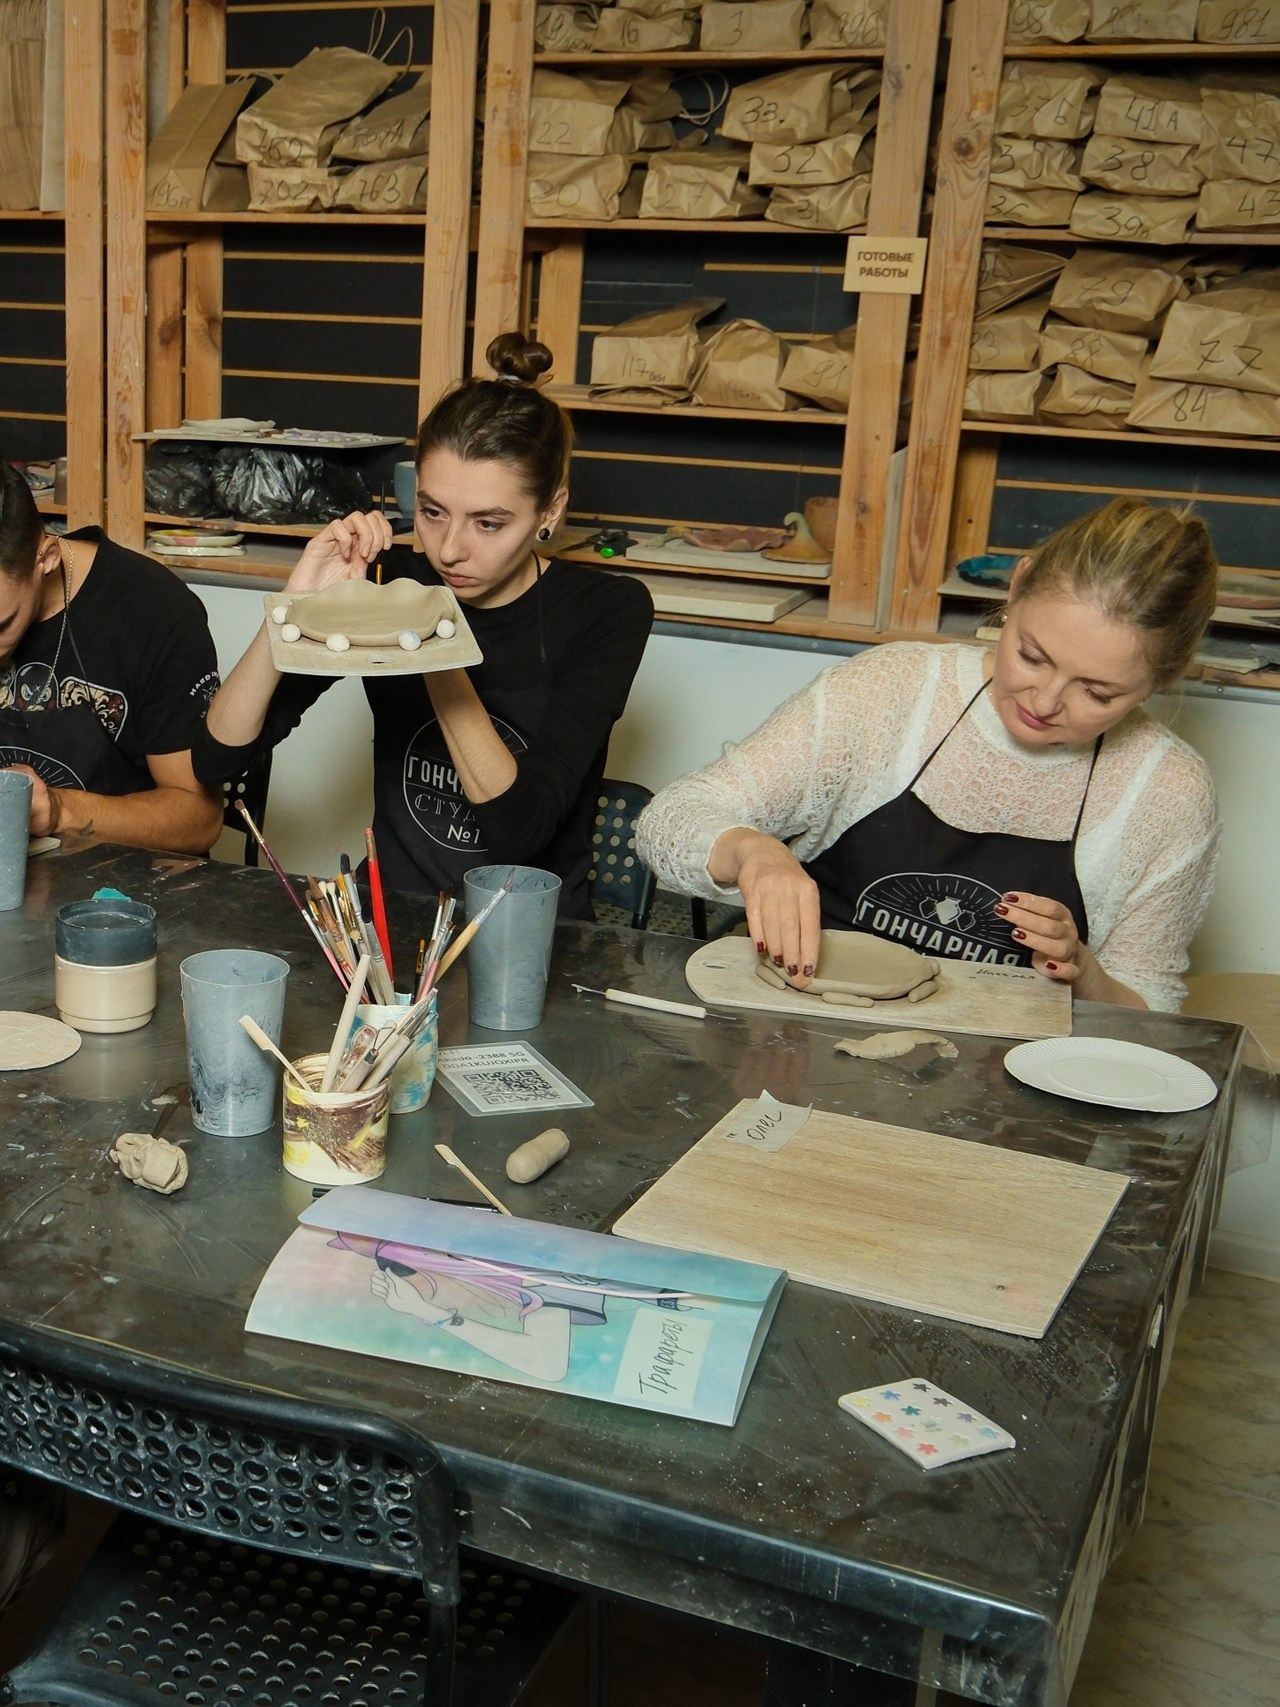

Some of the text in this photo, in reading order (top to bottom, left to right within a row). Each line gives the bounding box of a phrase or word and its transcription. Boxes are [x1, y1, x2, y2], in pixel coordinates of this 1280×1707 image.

[619, 19, 639, 46] 16
[724, 10, 743, 46] 3
[536, 120, 573, 147] 22
[772, 146, 823, 176] 32
[1101, 145, 1156, 181] 38
[359, 175, 402, 204] 763
[857, 251, 914, 262] ГОТОВЫЕ
[859, 267, 909, 278] РАБОТЫ
[1197, 340, 1263, 375] 77
[1173, 387, 1210, 422] 84
[408, 756, 464, 795] ГОНЧ
[447, 824, 481, 844] №1
[858, 900, 1021, 967] ГОНЧАРНАЯ
[638, 1319, 694, 1394] Трафареты
